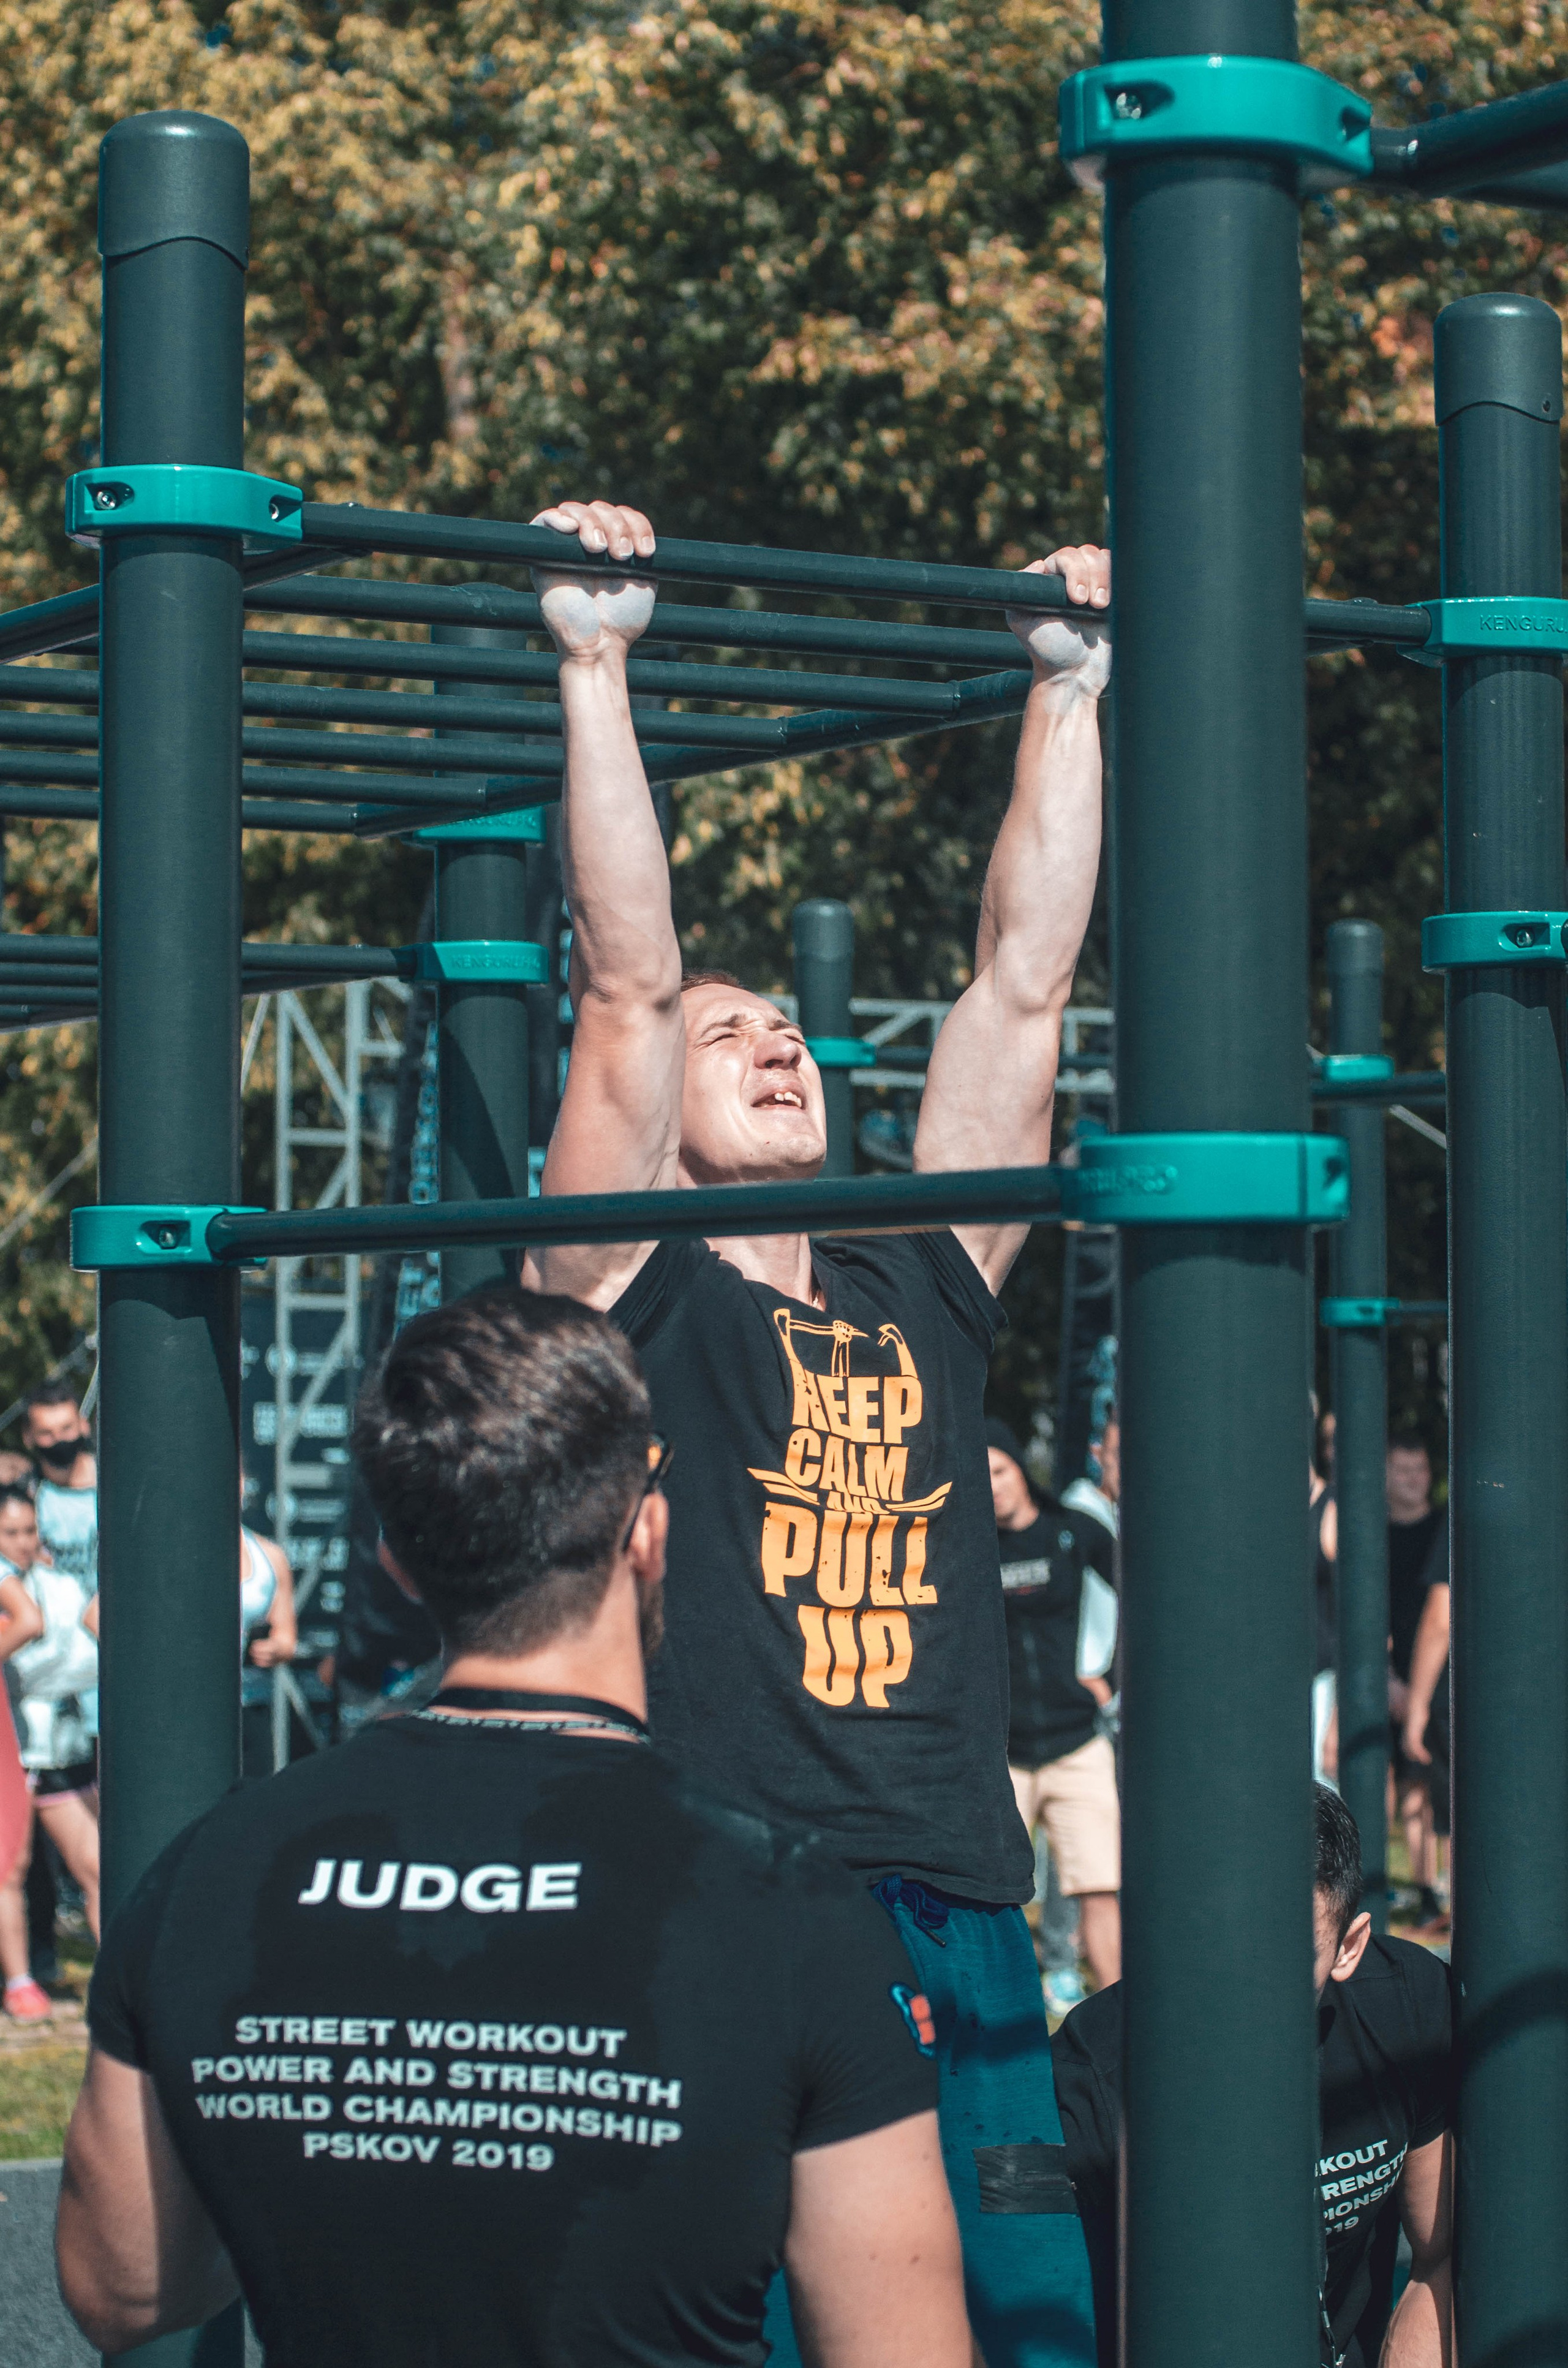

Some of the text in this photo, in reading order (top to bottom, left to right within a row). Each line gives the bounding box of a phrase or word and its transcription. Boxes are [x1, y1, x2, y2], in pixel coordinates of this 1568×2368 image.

[792, 1370, 922, 1444] KEEP
[785, 1428, 908, 1502] CALM
[761, 1501, 938, 1608] PULL
[797, 1603, 913, 1708] UP
[298, 1858, 581, 1913] JUDGE
[235, 2016, 627, 2058] STREET WORKOUT
[190, 2055, 682, 2109] POWER AND STRENGTH
[195, 2094, 682, 2147] WORLD CHAMPIONSHIP
[303, 2132, 554, 2171] PSKOV 2019
[1314, 2139, 1388, 2177] KOUT
[1321, 2142, 1408, 2201] RENGTH
